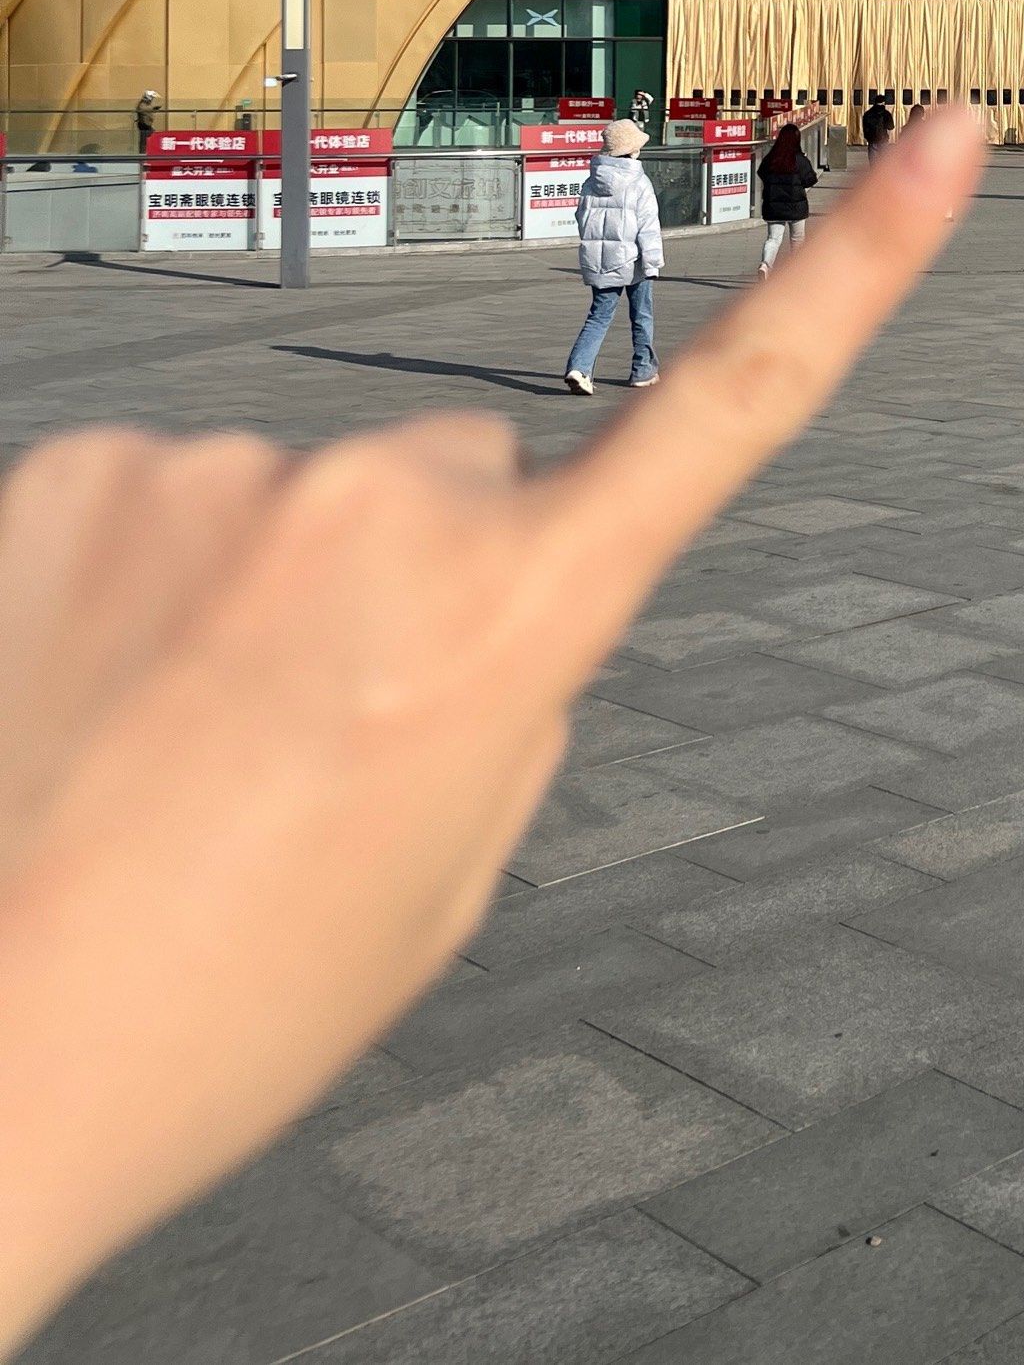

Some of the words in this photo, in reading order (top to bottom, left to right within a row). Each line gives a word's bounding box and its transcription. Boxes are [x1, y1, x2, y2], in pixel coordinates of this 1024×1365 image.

[161, 137, 246, 151] 新一代体验店
[310, 135, 371, 149] 代体验店
[149, 193, 256, 208] 宝明斋眼镜连锁
